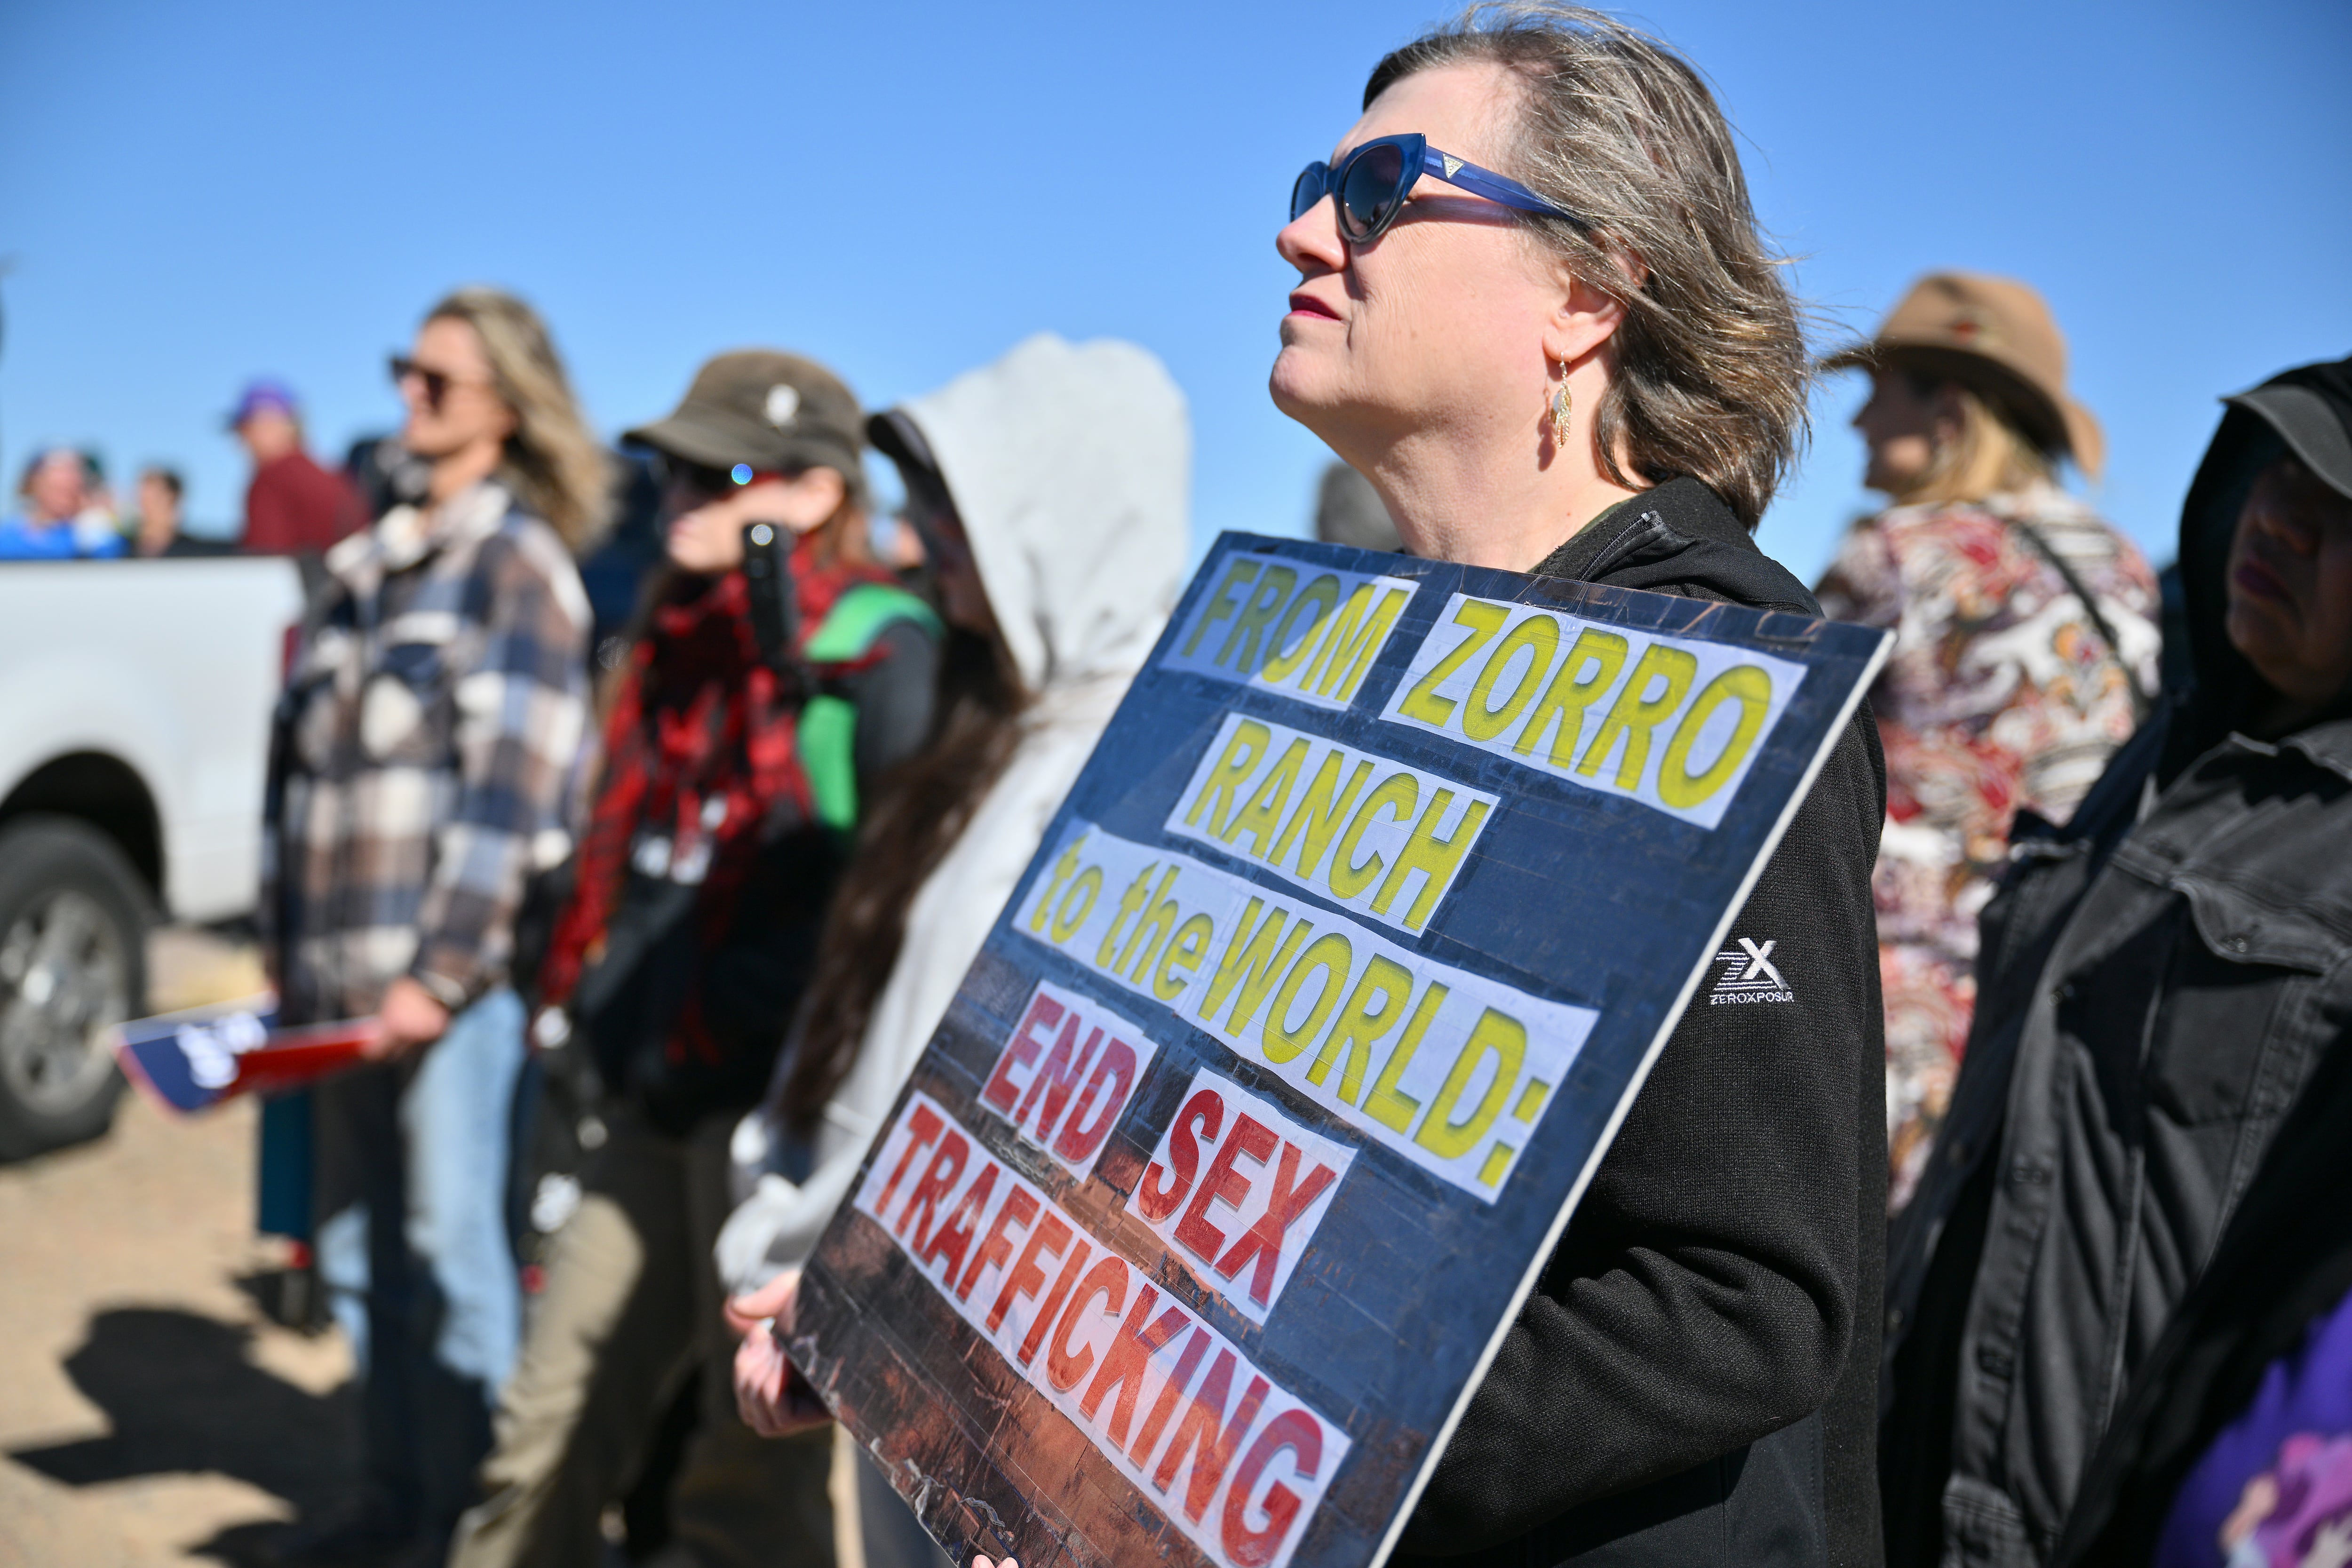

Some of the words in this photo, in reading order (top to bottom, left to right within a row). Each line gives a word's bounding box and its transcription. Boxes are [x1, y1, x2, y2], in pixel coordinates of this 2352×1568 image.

[1180, 559, 1409, 701] FROM
[1398, 599, 1772, 809] ZORRO
[1184, 720, 1490, 930] RANCH
[1029, 834, 1103, 943] to
[1095, 860, 1215, 1000] the
[1198, 895, 1550, 1187] WORLD:
[1709, 992, 1794, 1005] ZEROXPOSUR
[983, 993, 1137, 1164] END
[1137, 1089, 1336, 1310] SEX
[876, 1103, 1323, 1568] TRAFFICKING
